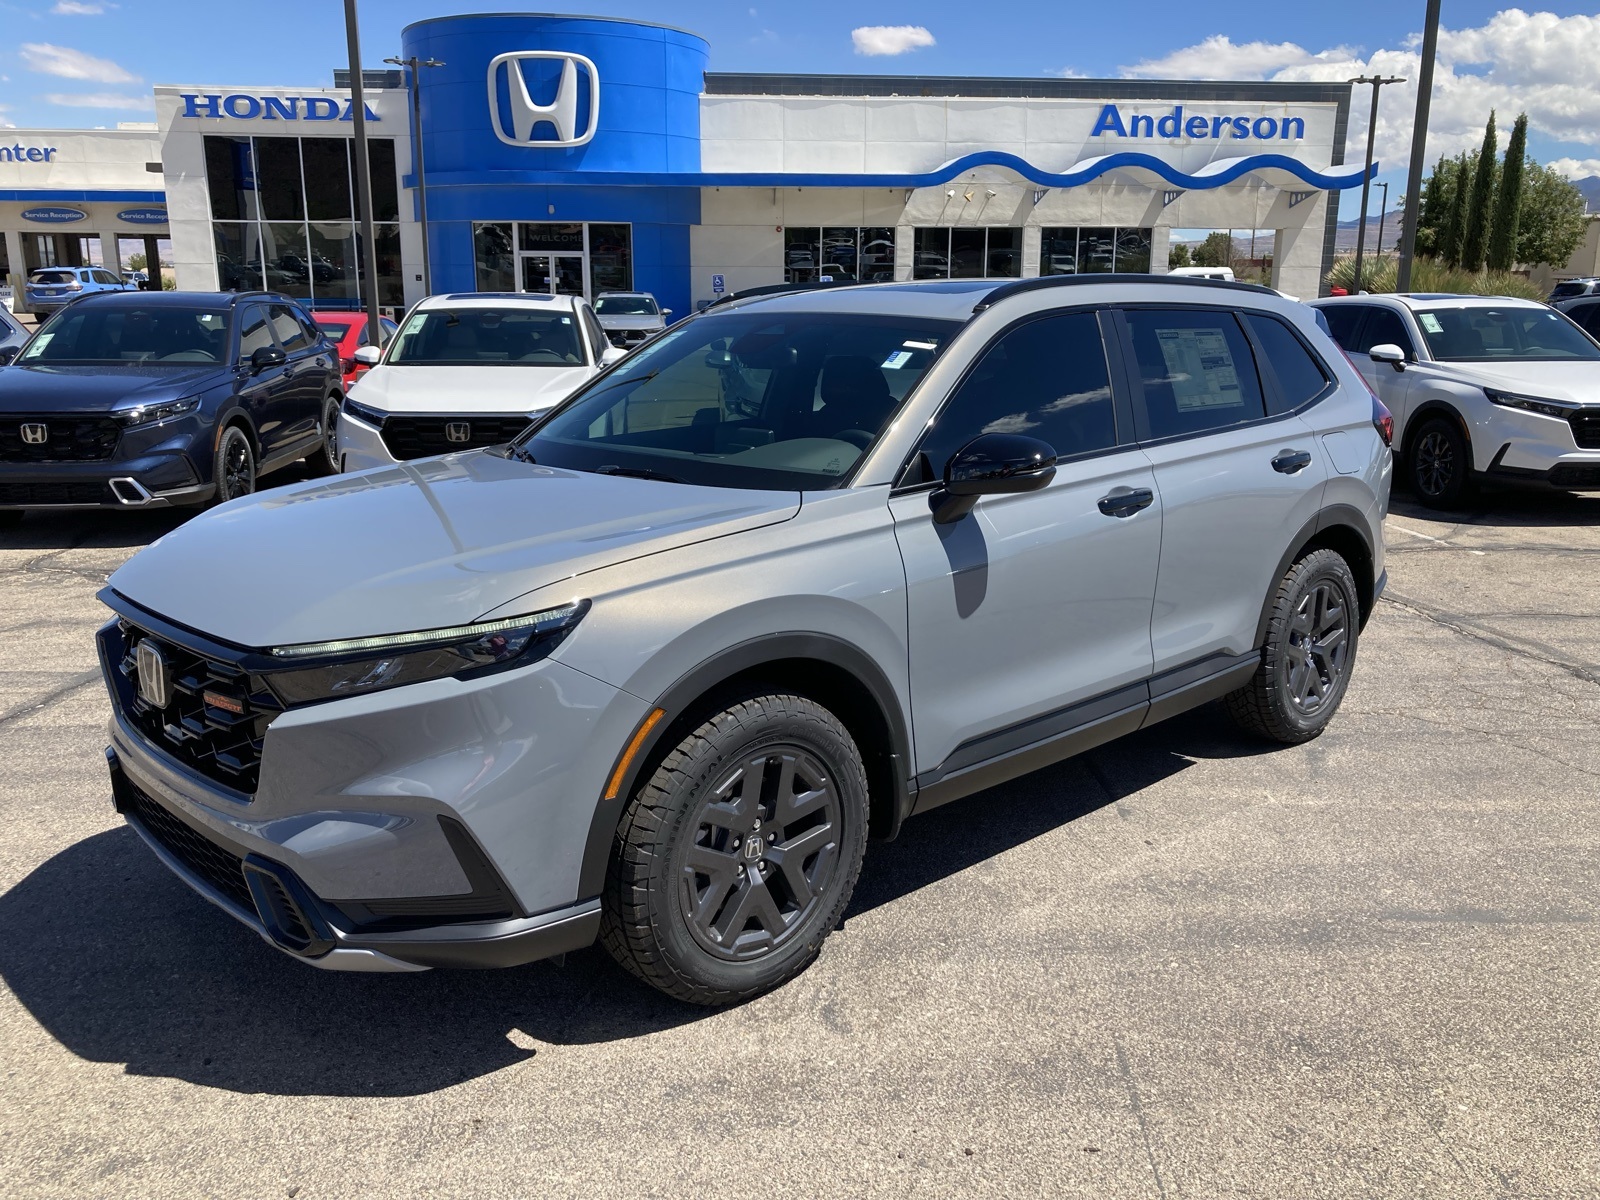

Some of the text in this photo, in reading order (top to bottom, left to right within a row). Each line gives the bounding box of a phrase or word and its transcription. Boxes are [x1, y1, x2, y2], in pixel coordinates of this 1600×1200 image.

[180, 94, 381, 121] HONDA
[1091, 104, 1305, 139] Anderson
[0, 143, 57, 162] nter
[50, 212, 82, 220] Reception
[529, 234, 584, 242] WELCOME
